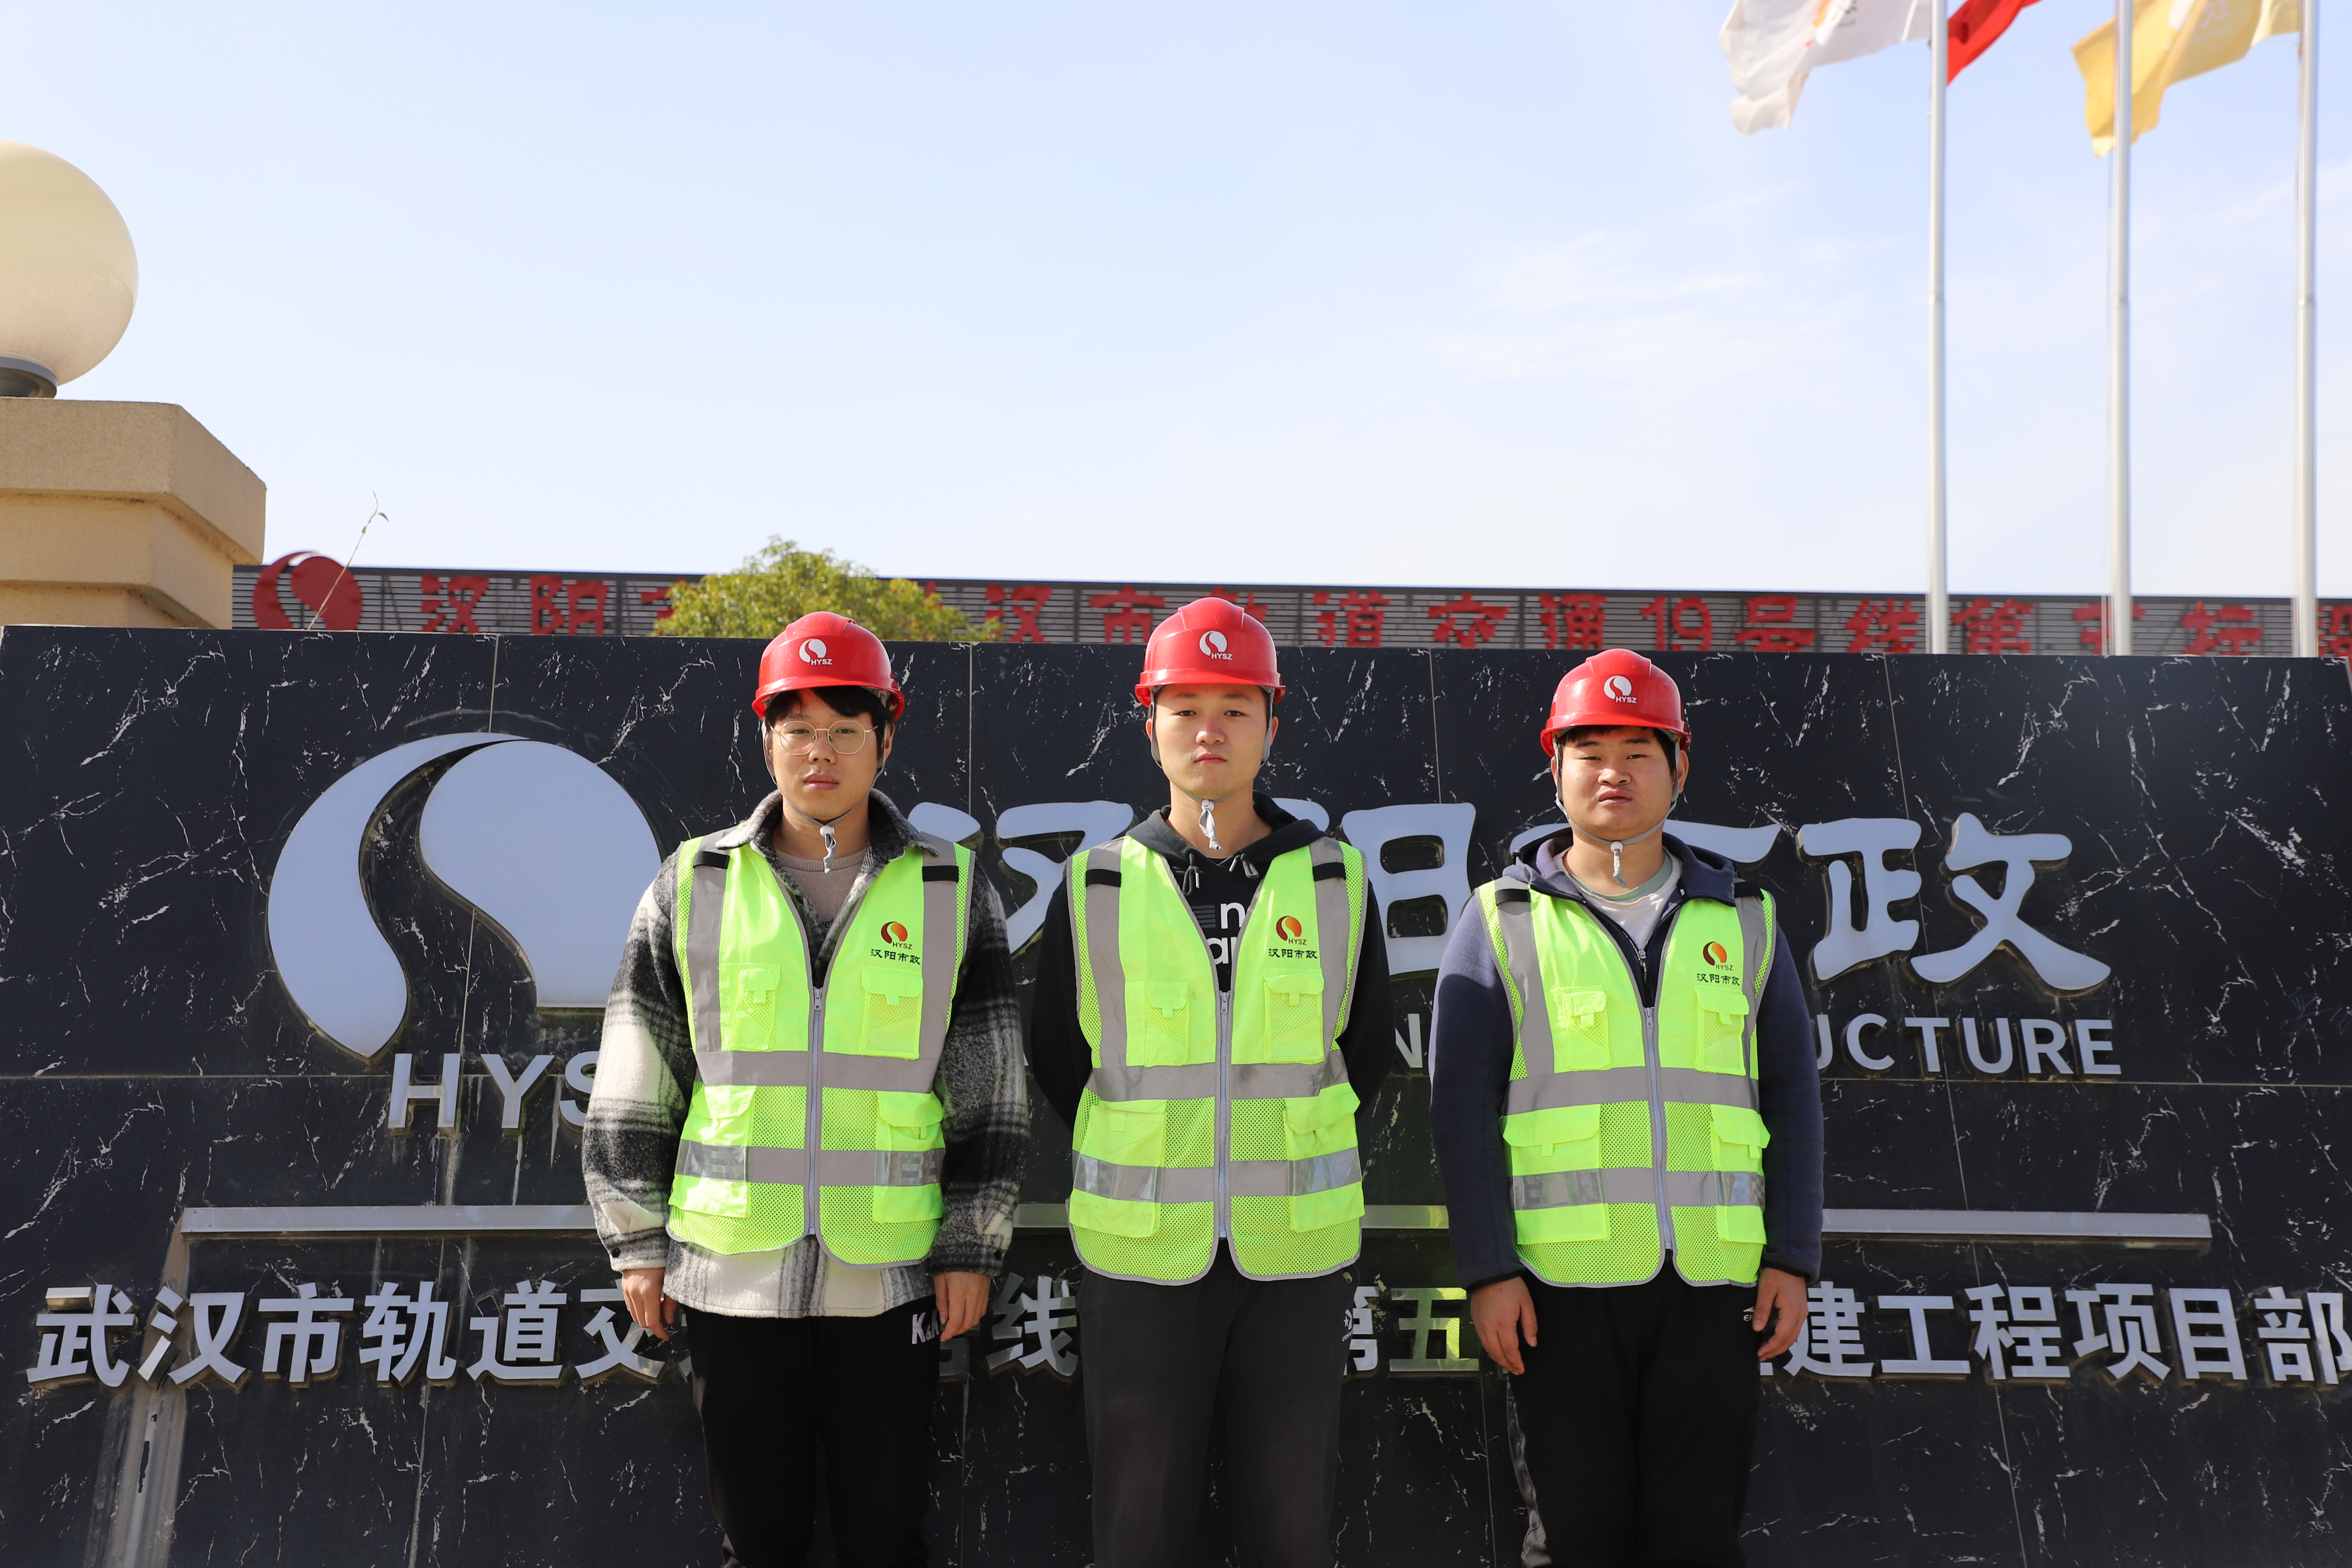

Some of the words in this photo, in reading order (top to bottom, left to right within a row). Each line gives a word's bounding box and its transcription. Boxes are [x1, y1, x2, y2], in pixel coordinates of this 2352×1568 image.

[870, 949, 920, 965] 汉阳市政
[1269, 948, 1318, 959] 汉阳市政
[1697, 973, 1740, 986] 汉阳市政
